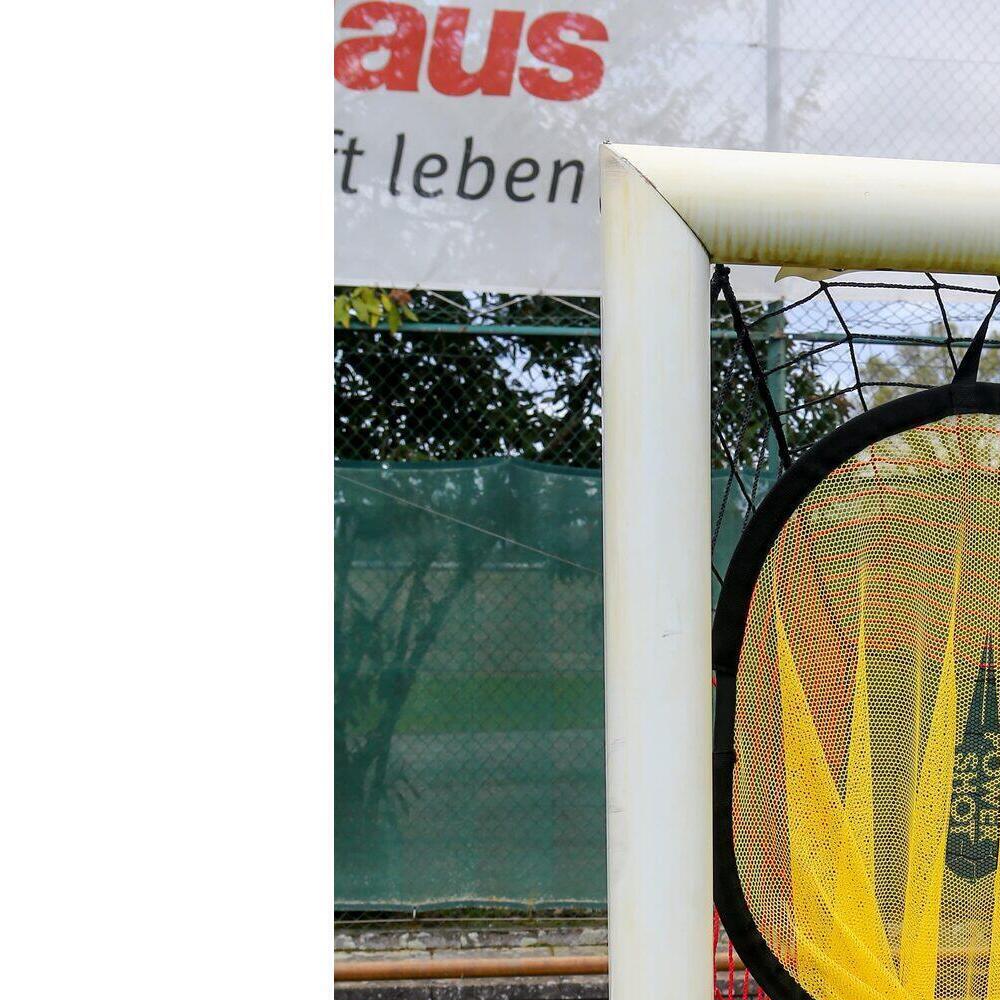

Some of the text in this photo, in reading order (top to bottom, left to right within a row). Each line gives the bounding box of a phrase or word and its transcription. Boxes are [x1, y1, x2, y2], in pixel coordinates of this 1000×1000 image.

[334, 0, 609, 101] aus
[388, 133, 585, 204] leben
[949, 752, 980, 845] SHOT
